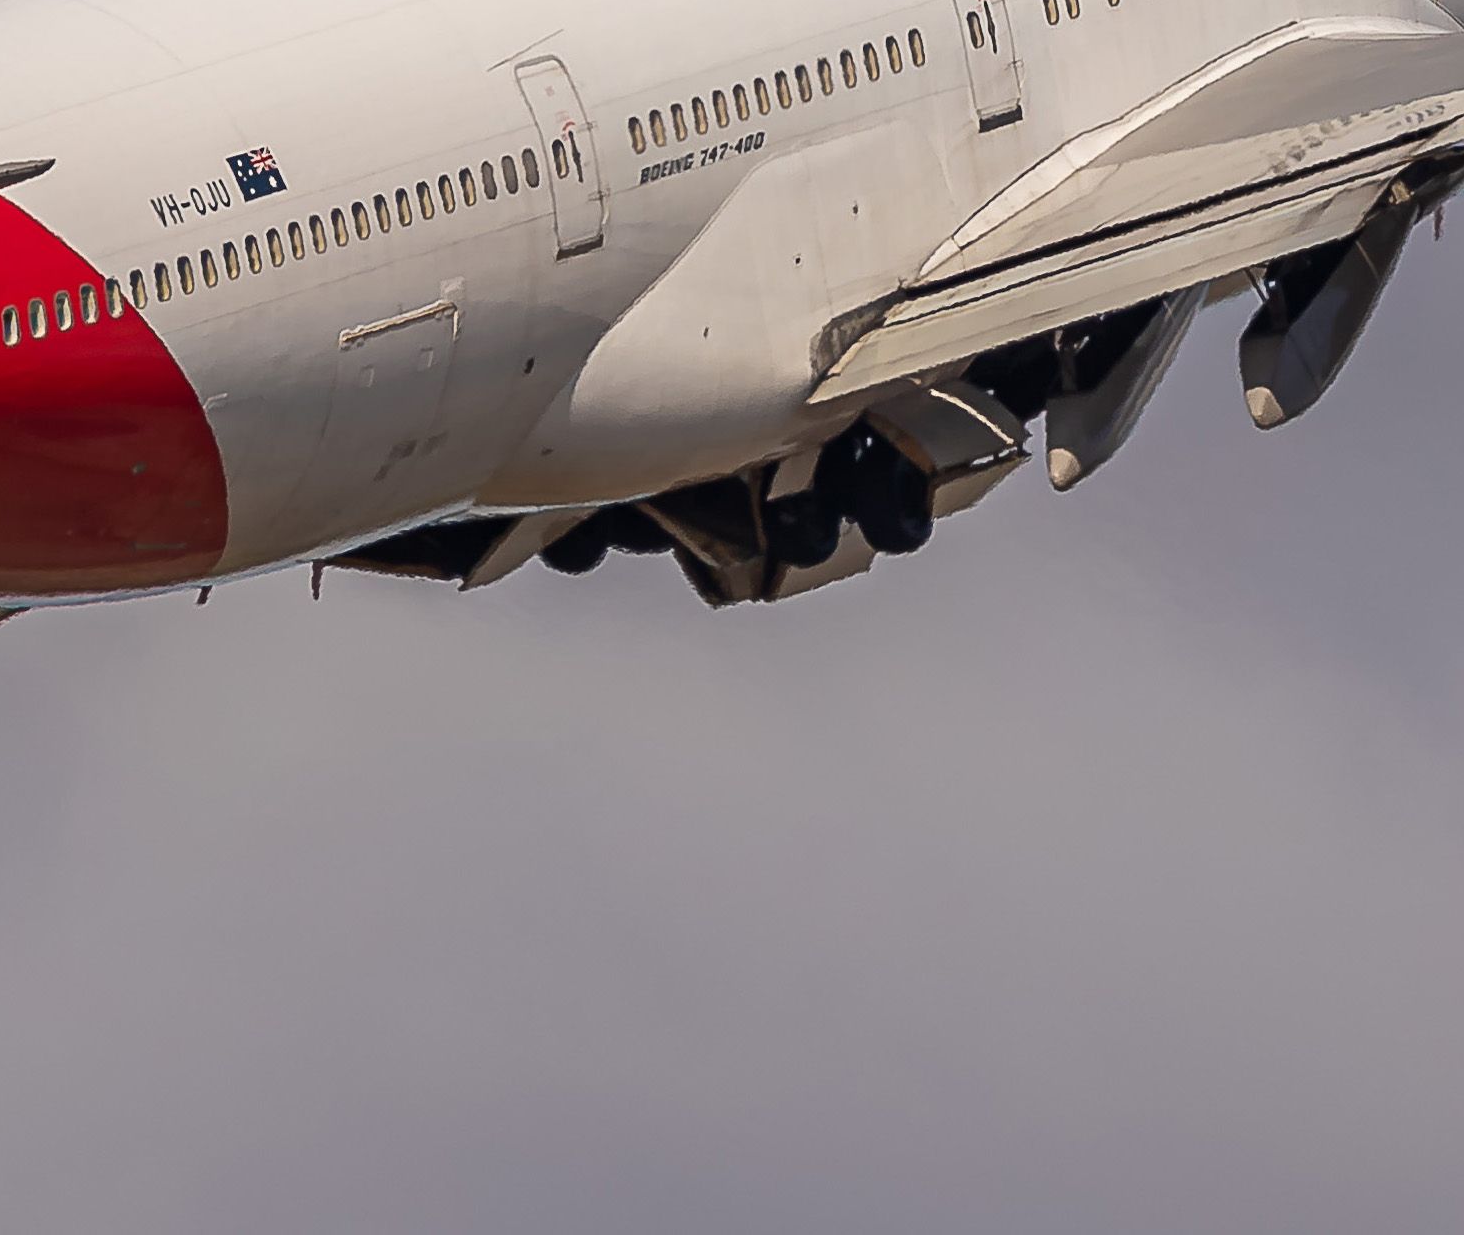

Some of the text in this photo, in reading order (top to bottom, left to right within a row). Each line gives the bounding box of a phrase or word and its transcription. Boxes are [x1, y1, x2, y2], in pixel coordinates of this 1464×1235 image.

[640, 131, 766, 185] BOEING 747-400
[150, 178, 231, 227] VH-OJU
